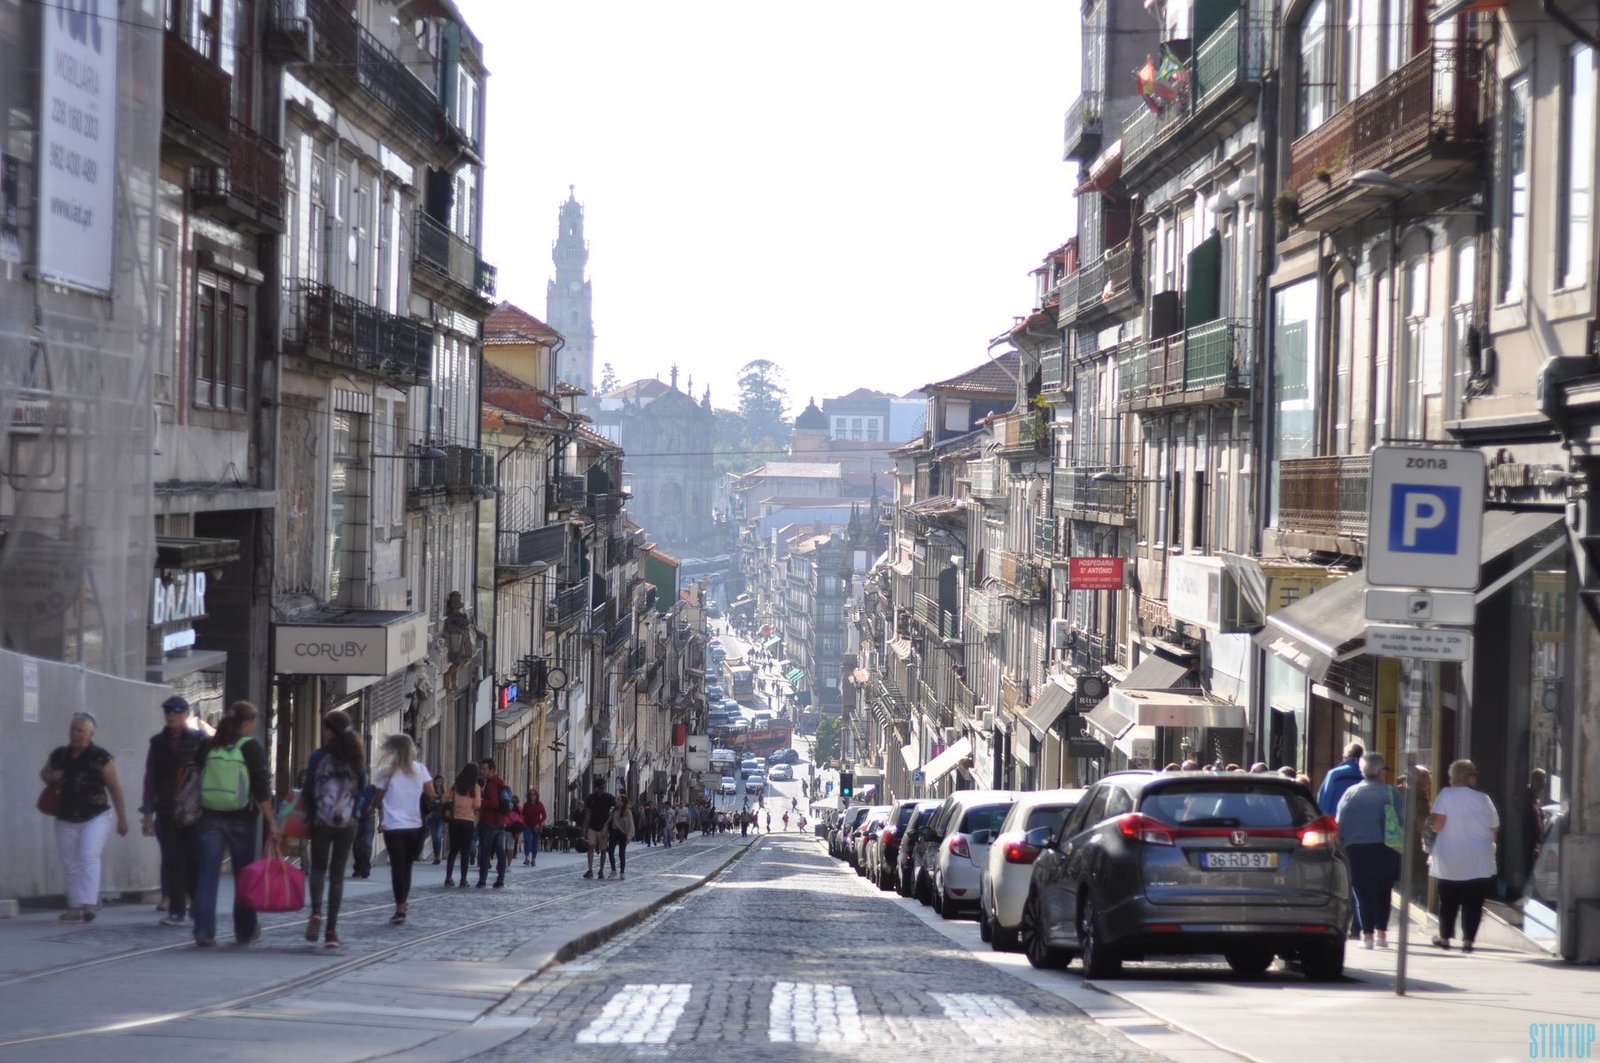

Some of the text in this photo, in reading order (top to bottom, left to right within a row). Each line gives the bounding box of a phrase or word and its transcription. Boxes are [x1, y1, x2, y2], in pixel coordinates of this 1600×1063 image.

[1406, 457, 1448, 469] zona
[1403, 492, 1445, 546] P
[153, 571, 206, 625] BAZAR
[294, 641, 368, 662] CORUBY
